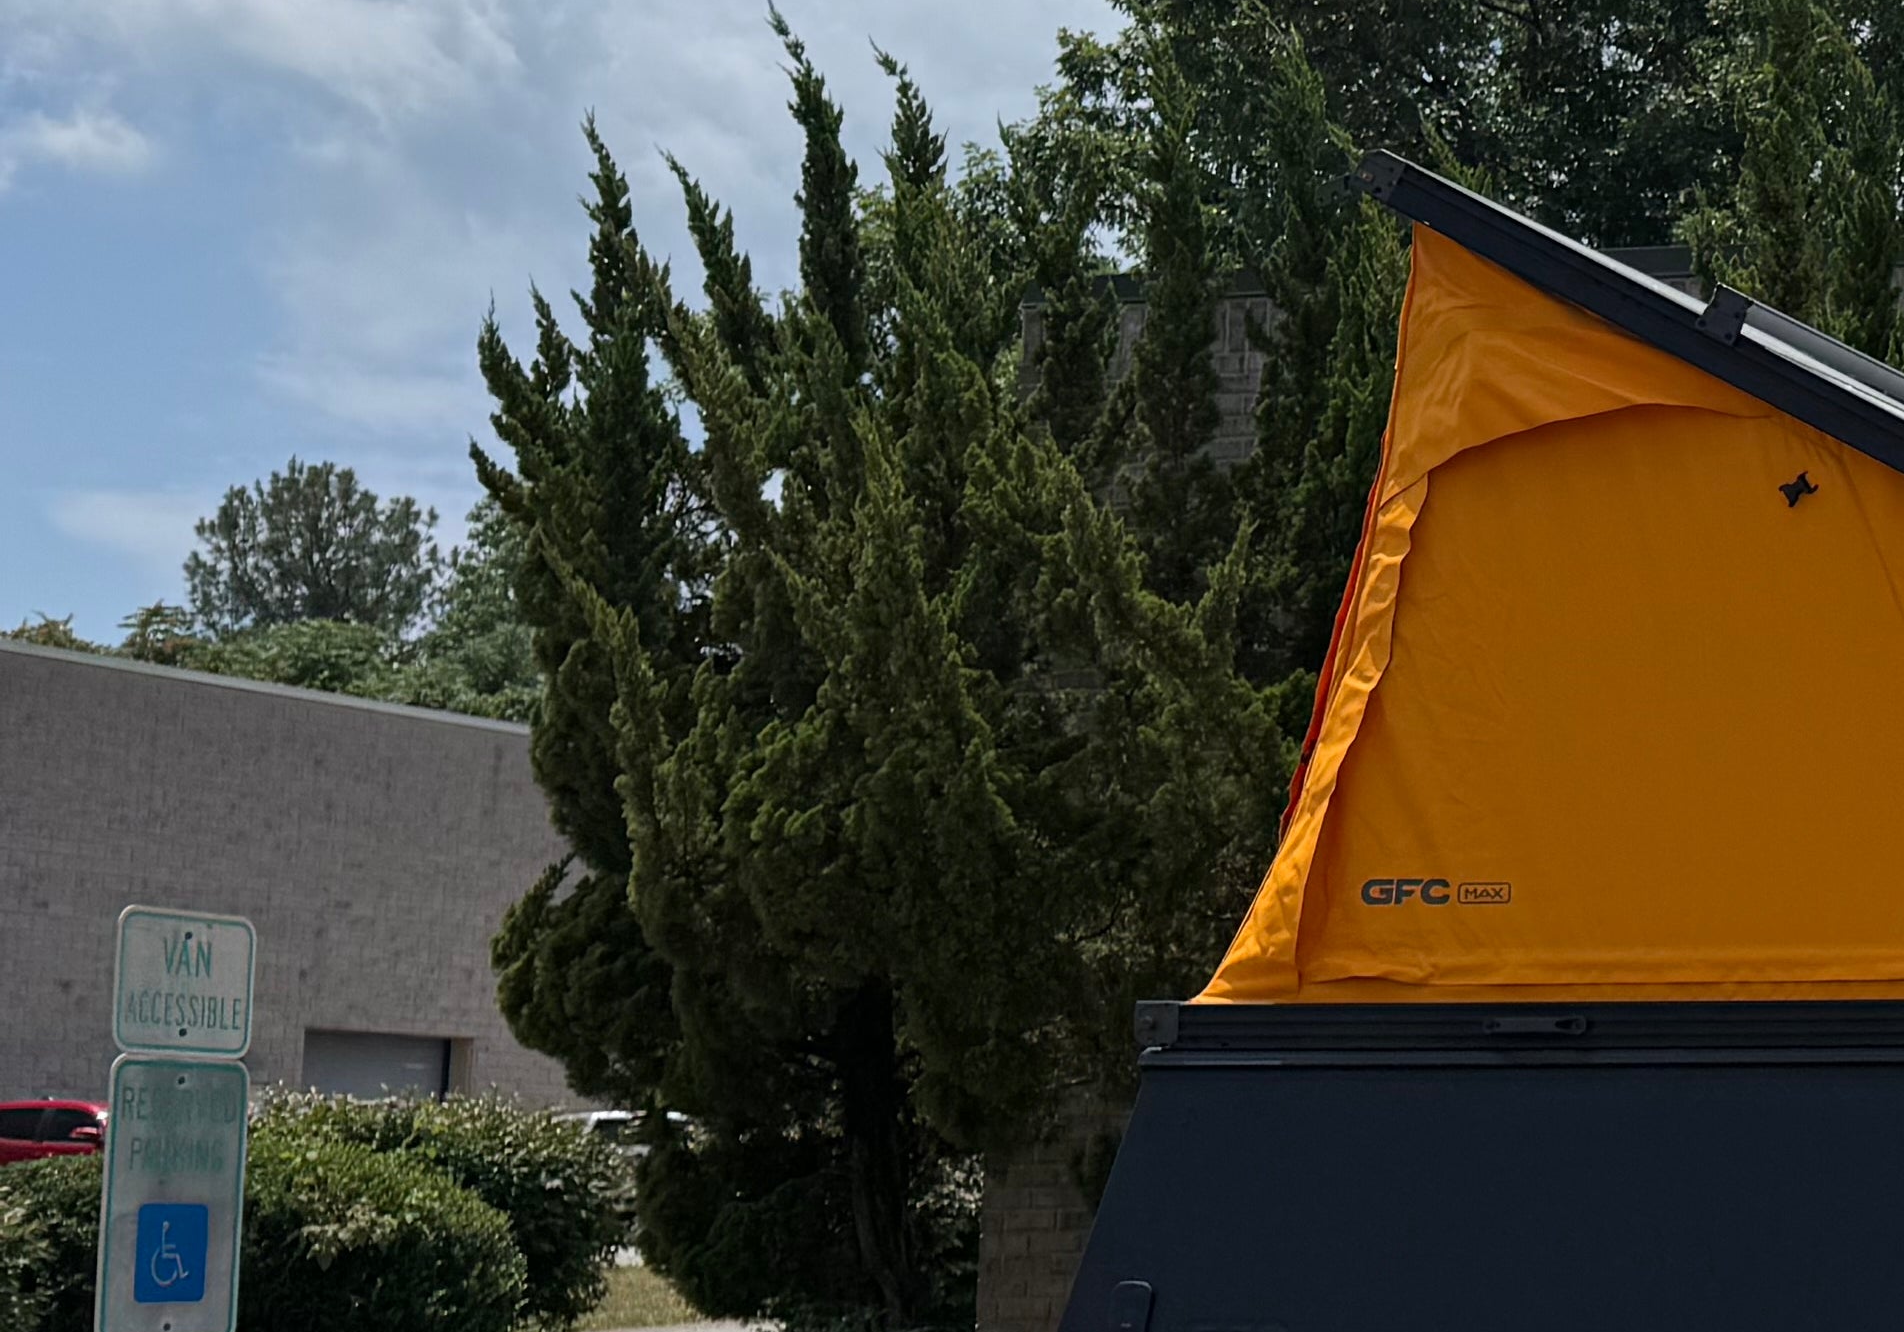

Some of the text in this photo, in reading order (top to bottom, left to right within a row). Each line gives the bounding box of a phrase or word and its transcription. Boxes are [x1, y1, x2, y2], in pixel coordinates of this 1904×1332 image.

[1361, 878, 1504, 905] GFC MAX
[164, 936, 213, 979] VAN
[125, 988, 242, 1031] ACCESSIBLE
